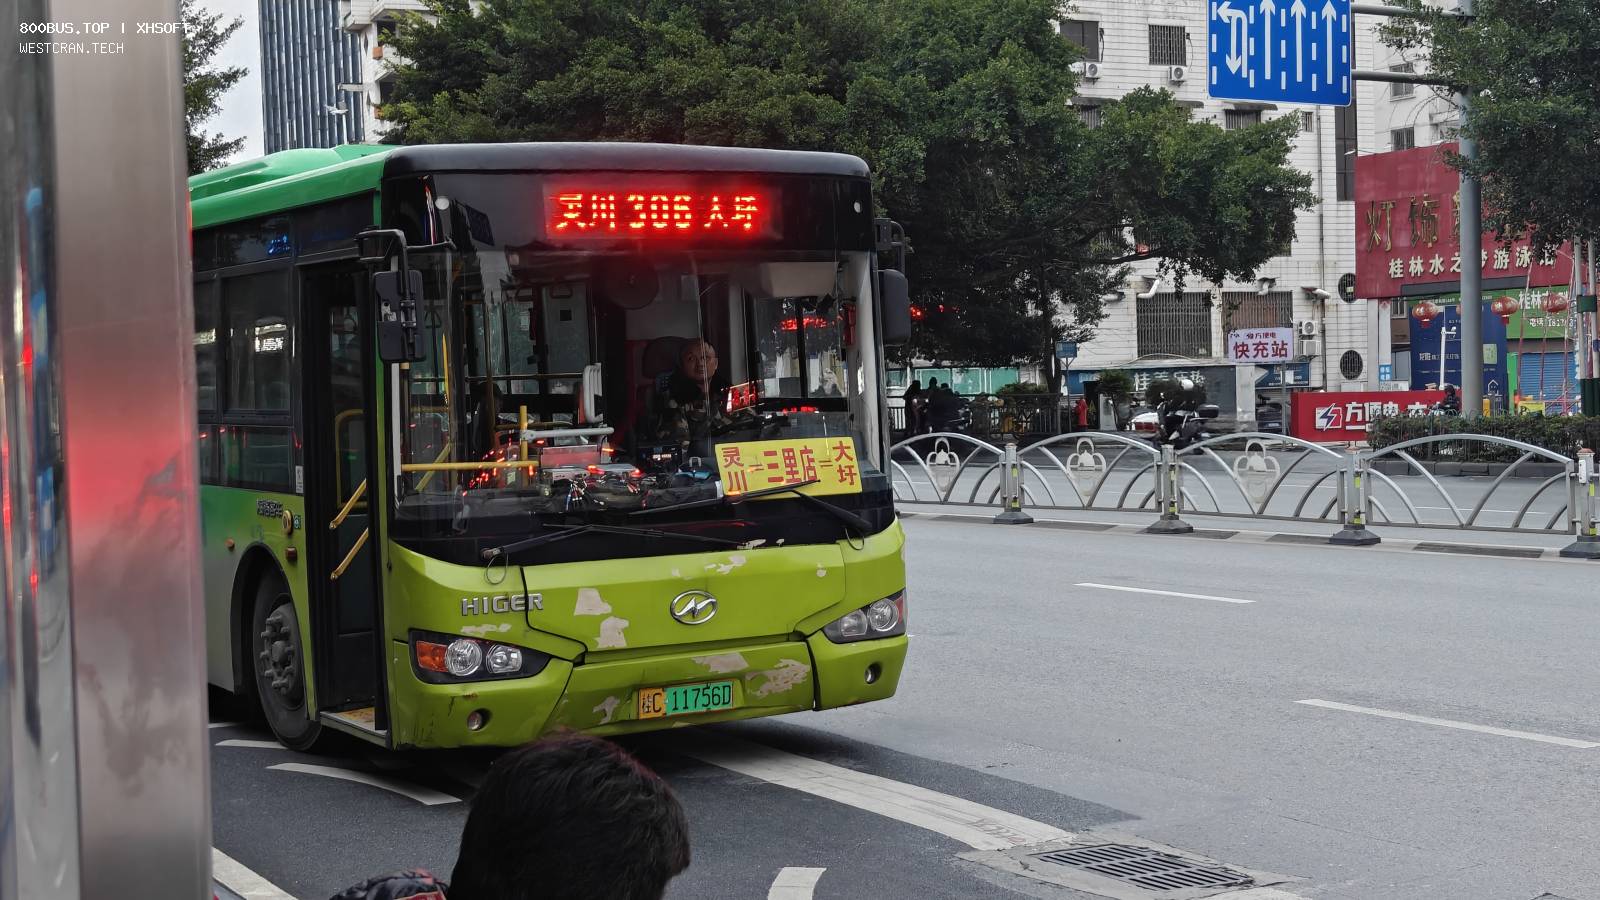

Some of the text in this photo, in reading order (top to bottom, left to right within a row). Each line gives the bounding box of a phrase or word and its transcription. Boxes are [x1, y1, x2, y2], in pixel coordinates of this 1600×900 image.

[627, 194, 692, 229] 306
[1233, 340, 1288, 359] 快充站
[721, 440, 858, 492] 灵川 三里店 大圩
[462, 593, 543, 616] HIGER
[672, 685, 732, 711] 11756D
